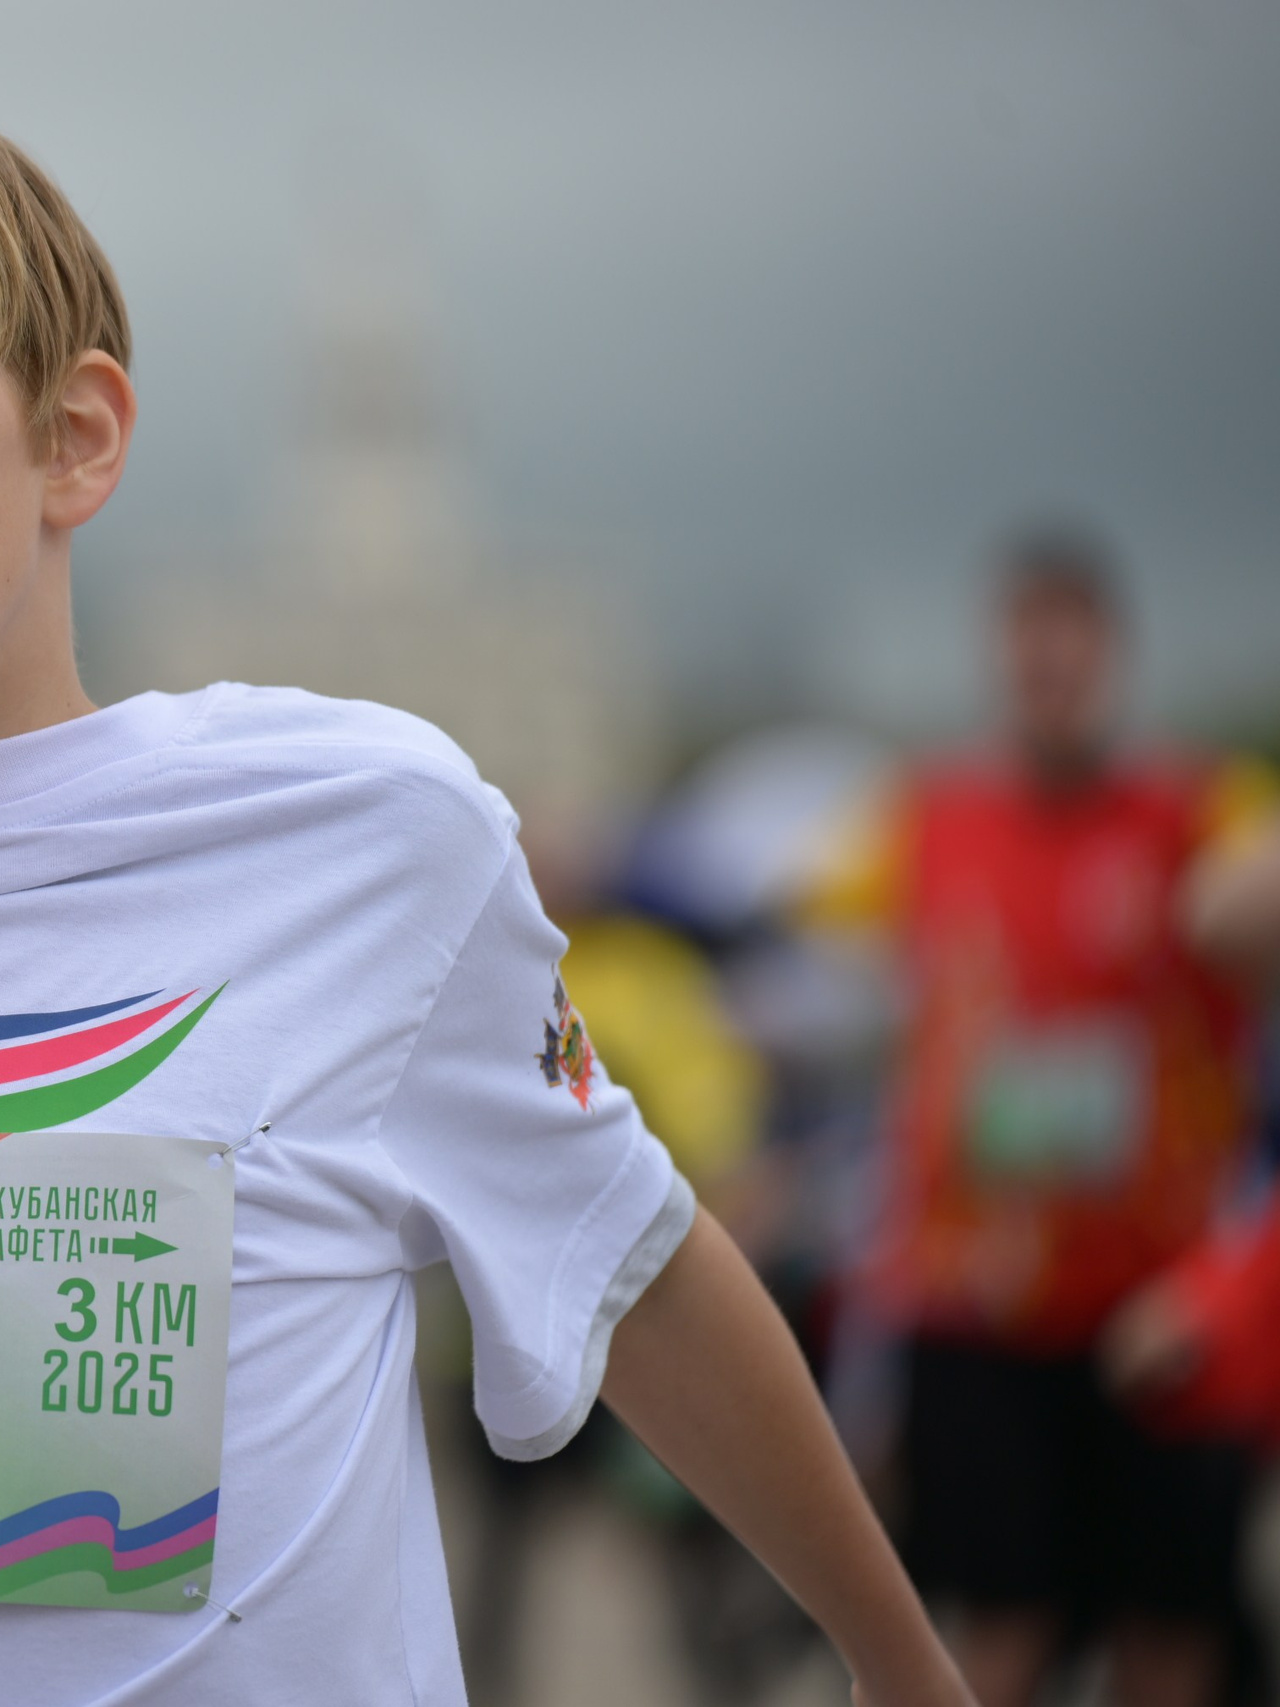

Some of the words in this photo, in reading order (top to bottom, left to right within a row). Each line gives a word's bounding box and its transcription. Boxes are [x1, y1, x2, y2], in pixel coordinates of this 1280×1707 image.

[54, 1277, 98, 1342] 3
[115, 1281, 197, 1347] КМ
[41, 1349, 174, 1417] 2025
